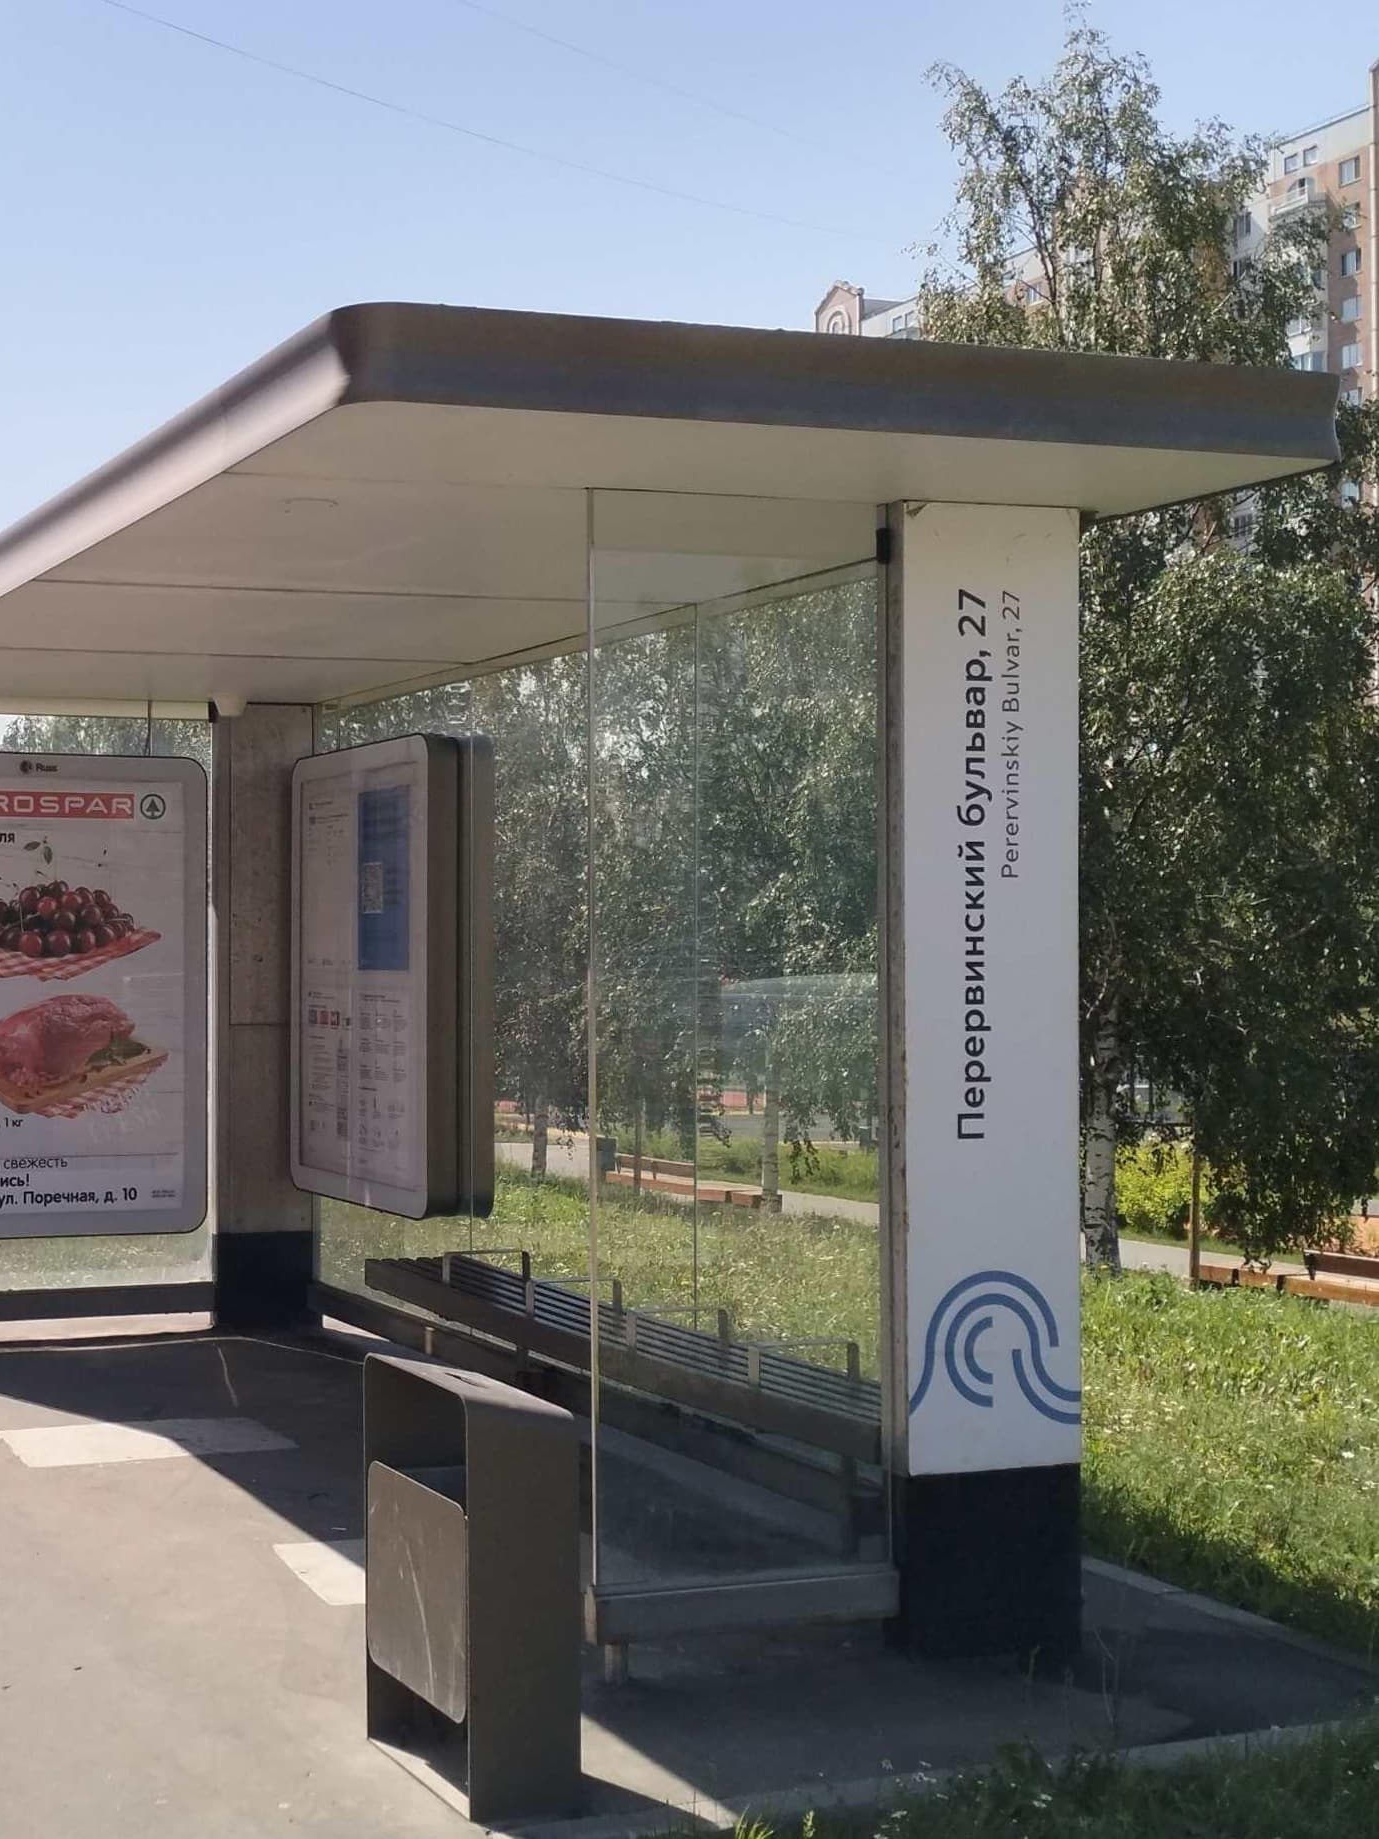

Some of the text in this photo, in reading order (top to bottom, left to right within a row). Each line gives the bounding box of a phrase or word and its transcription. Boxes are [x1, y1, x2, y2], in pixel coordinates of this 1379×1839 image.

[1001, 590, 1024, 879] Perervinskiy Bulvar, 27
[957, 588, 993, 1140] Перервинский бульвар, 27
[12, 1118, 24, 1127] кг
[3, 1157, 68, 1169] свежесть
[23, 1191, 100, 1205] Поречная,
[104, 1191, 119, 1204] д.
[123, 1187, 138, 1201] 10
